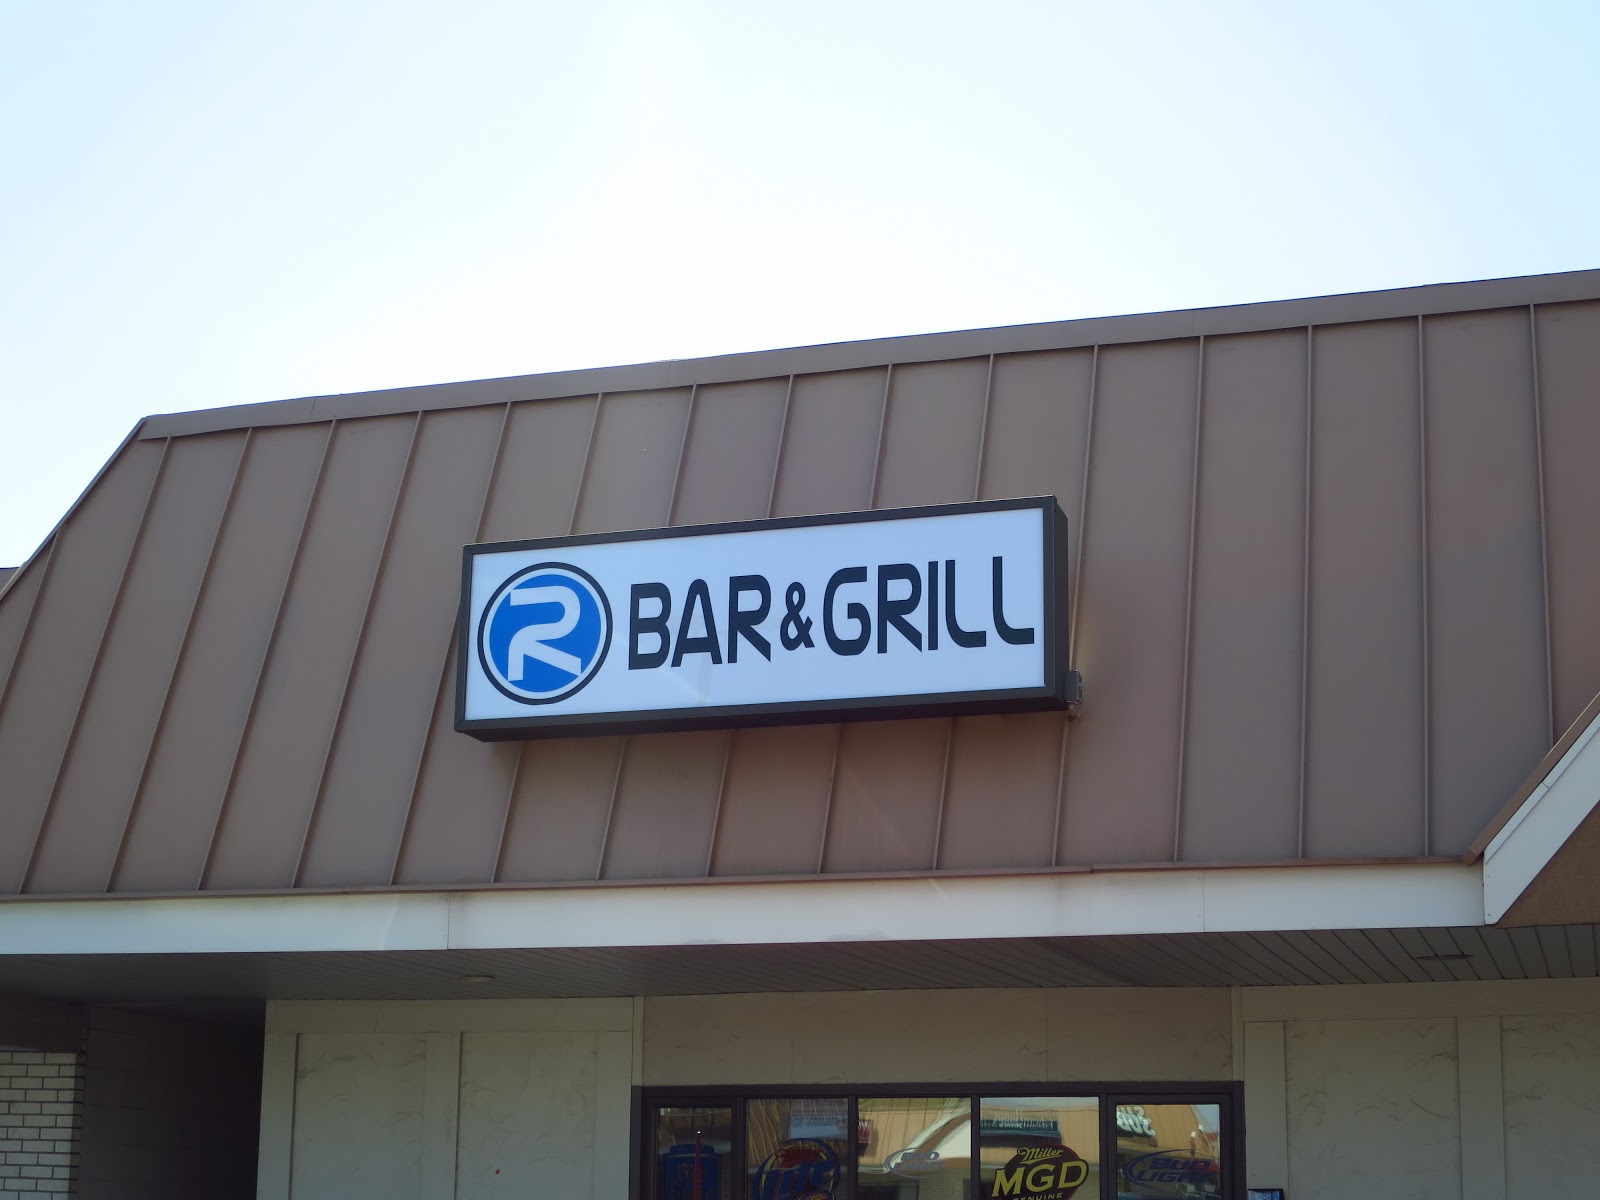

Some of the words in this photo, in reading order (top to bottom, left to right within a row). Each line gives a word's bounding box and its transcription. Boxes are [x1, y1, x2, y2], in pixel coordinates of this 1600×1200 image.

[508, 585, 582, 682] R
[1017, 1147, 1065, 1164] Miller
[1150, 1158, 1211, 1170] BUD
[991, 1160, 1087, 1198] MGD
